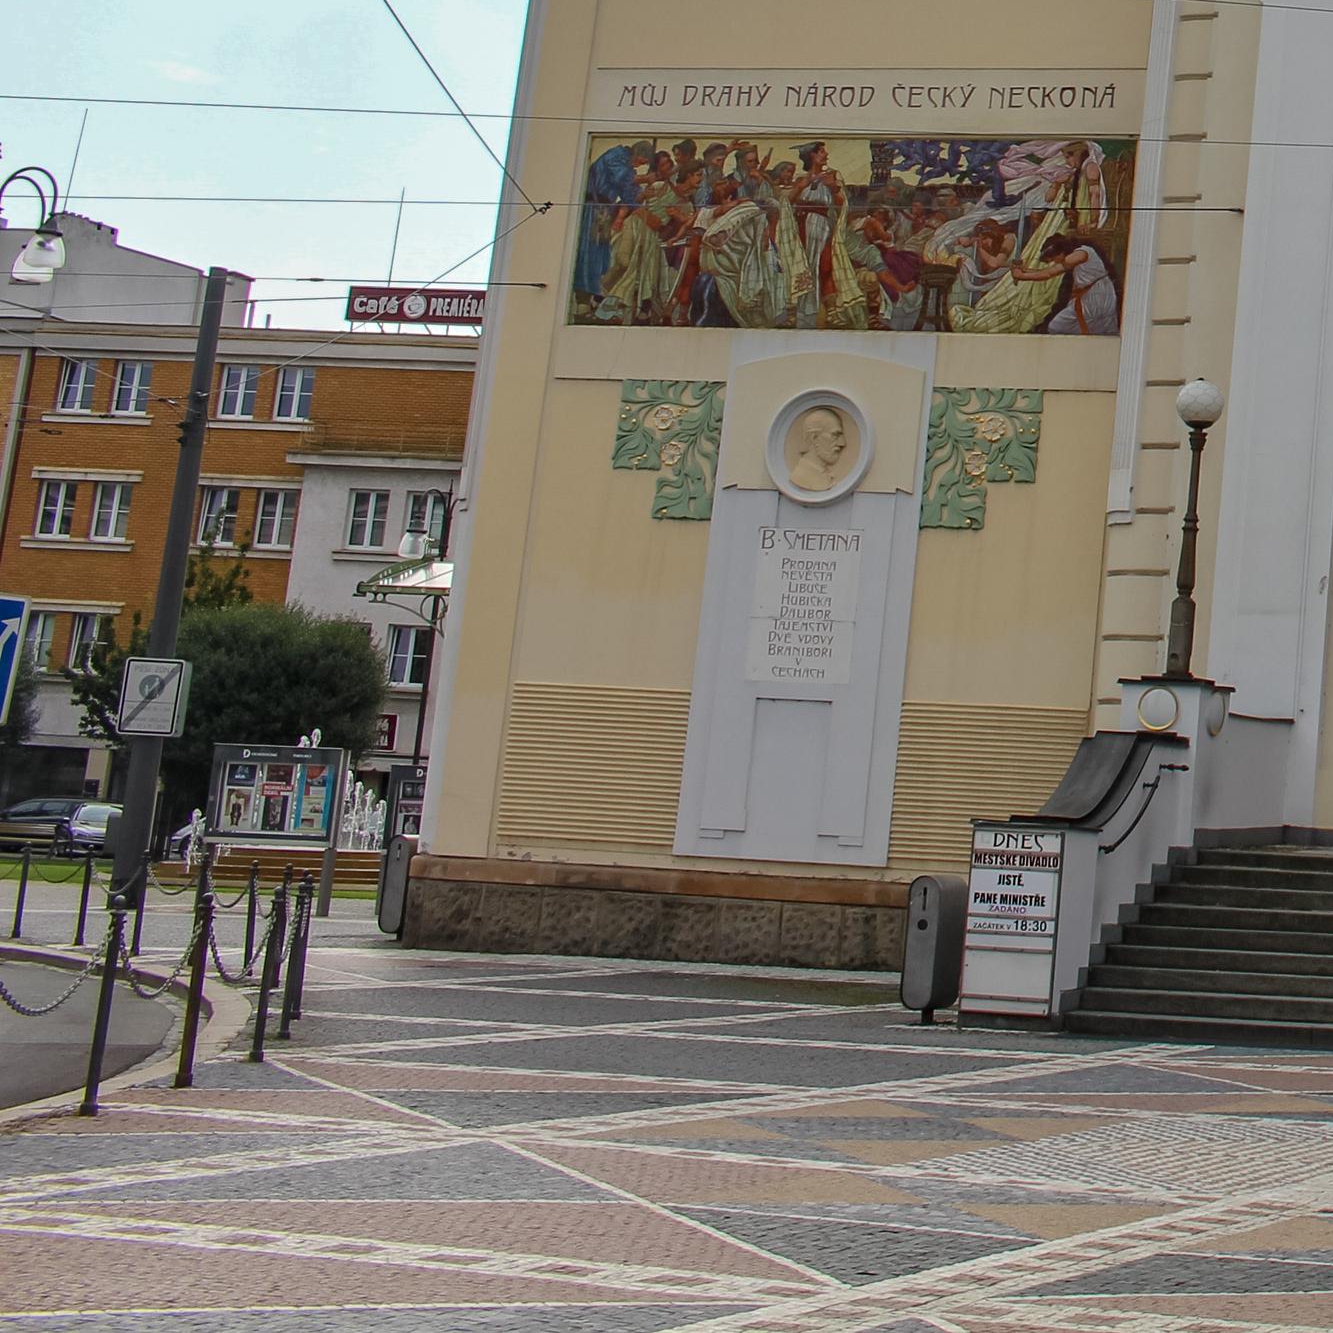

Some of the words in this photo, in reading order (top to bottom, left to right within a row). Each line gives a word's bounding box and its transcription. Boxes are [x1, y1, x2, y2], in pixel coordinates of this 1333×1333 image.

[682, 84, 771, 107] DRAHÝ
[785, 84, 875, 108] NÁROD
[892, 83, 976, 108] ČESKÝ
[784, 531, 860, 551] SMETANA
[780, 607, 832, 619] DALIBOR
[799, 635, 833, 645] VDOVY
[993, 833, 1044, 852] DNES
[1019, 855, 1059, 868] DIVADLO
[974, 892, 998, 904] PANE
[1014, 920, 1047, 932] 18:30
